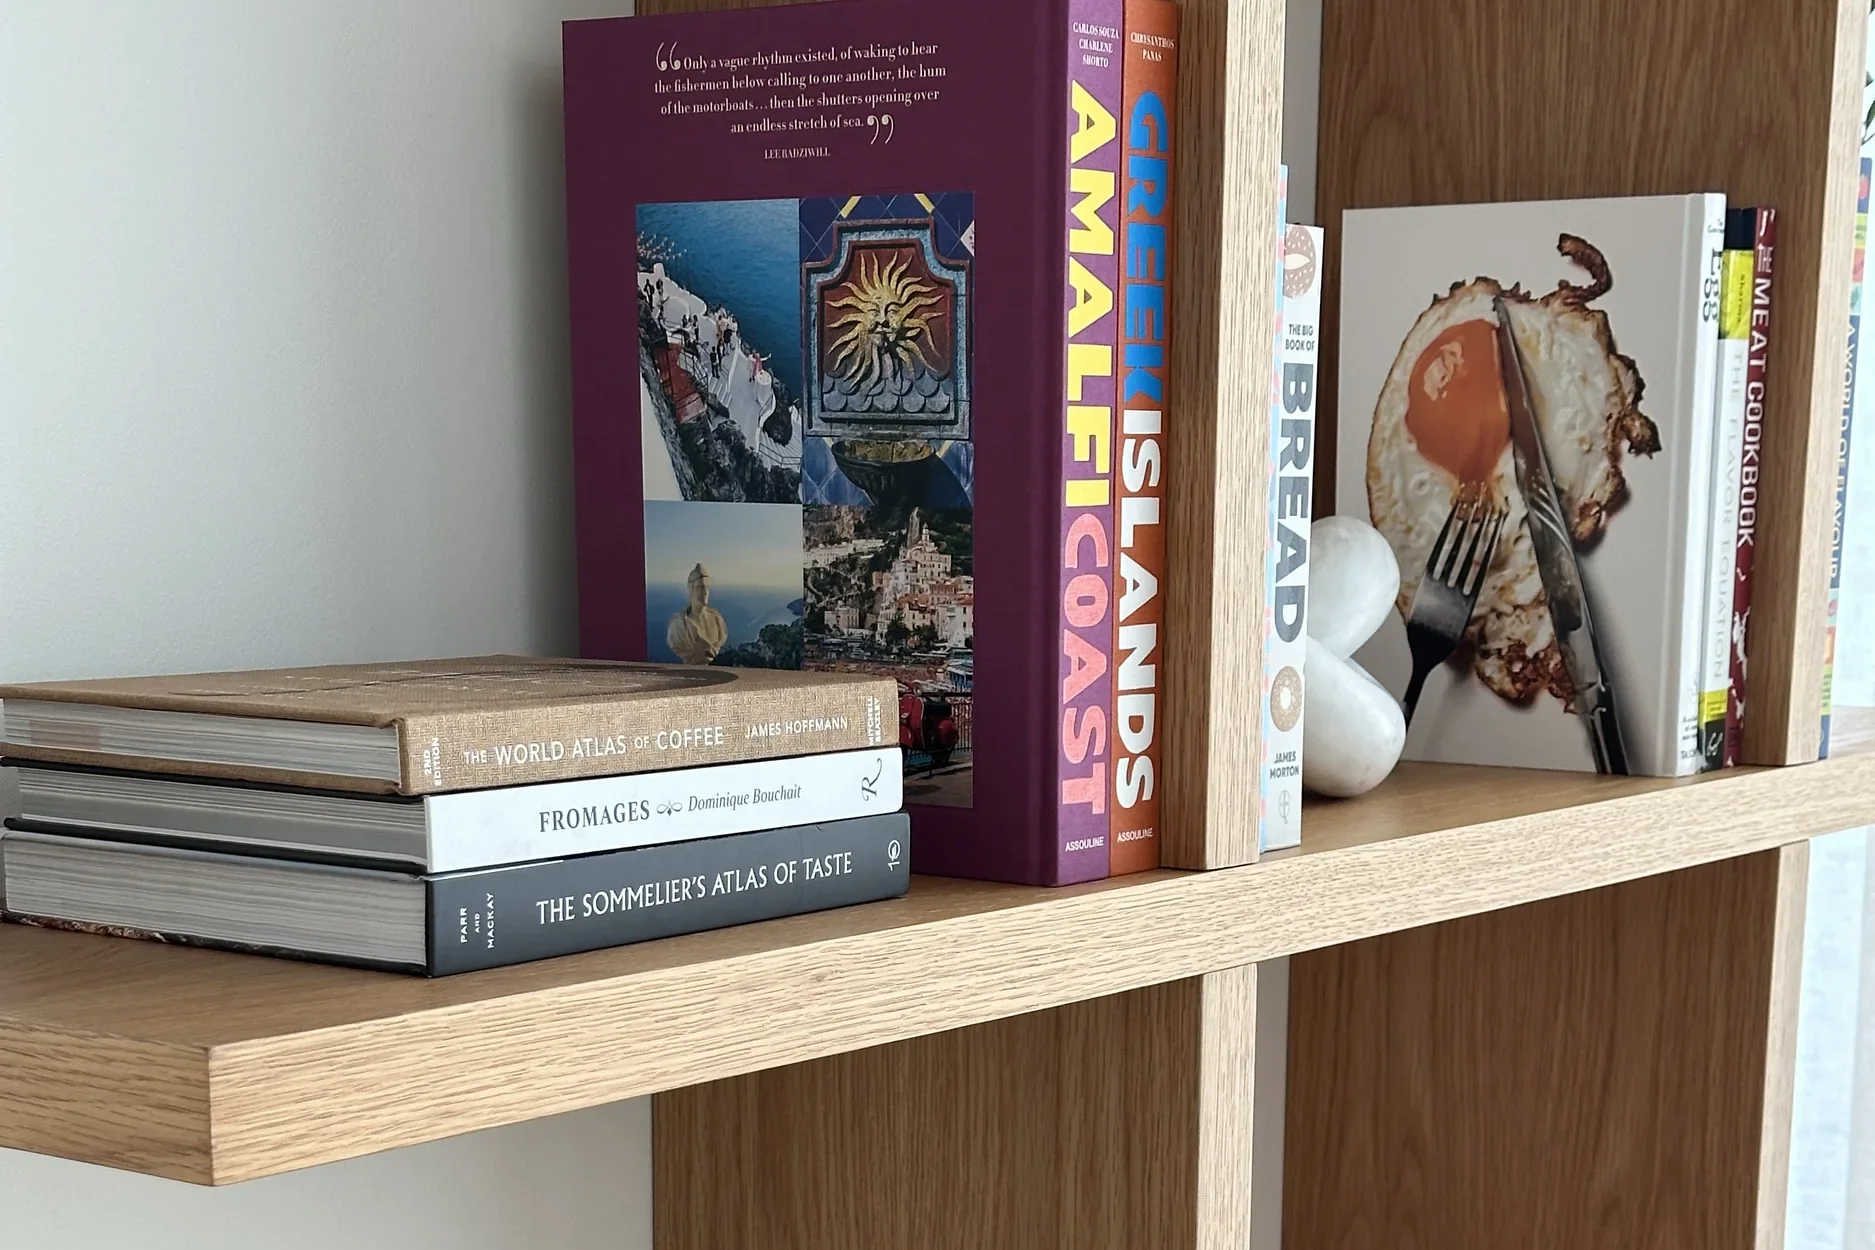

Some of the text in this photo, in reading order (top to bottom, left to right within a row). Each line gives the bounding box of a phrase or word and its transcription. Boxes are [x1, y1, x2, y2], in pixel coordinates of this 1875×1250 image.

[1073, 22, 1119, 39] CARLOS SOUZA
[1130, 32, 1175, 49] CHRYSANTHOS
[710, 58, 717, 69] a
[719, 56, 750, 72] vague
[751, 50, 793, 70] rhythm
[794, 46, 838, 63] existed,
[840, 46, 853, 60] of
[854, 44, 896, 62] waking
[898, 44, 909, 57] to
[911, 40, 939, 56] hear
[1078, 38, 1114, 54] CHARLENE
[1082, 54, 1109, 68] SHORTO
[1142, 49, 1162, 62] PANAS
[654, 63, 947, 93] the fishermen below calling to one another, the hum
[660, 100, 672, 115] of
[673, 100, 691, 114] the
[797, 93, 815, 108] the
[816, 92, 863, 107] shutters
[864, 88, 912, 109] opening
[913, 90, 940, 101] over
[730, 124, 744, 133] an
[746, 117, 787, 132] endless
[788, 114, 828, 130] stretch
[829, 113, 843, 129] of
[764, 147, 831, 160] LEE RADZIWILL
[1065, 80, 1117, 507] AMALFI
[1288, 323, 1314, 337] THE BIG
[1749, 278, 1772, 373] MEAT
[1284, 338, 1315, 352] BOOK OF
[1116, 91, 1168, 810] GREEK ISLANDS
[1737, 381, 1765, 548] COOKBOOK
[1274, 363, 1314, 643] BREAD
[1062, 513, 1109, 815] COAST
[744, 715, 849, 740] JAMES HOFFMANN
[866, 699, 874, 746] MITCHELL
[873, 698, 882, 743] BEAZLEY
[463, 749, 490, 765] THE
[494, 740, 566, 766] WORLD
[571, 735, 627, 761] ATLAS
[656, 725, 725, 751] COFFEE
[1273, 750, 1297, 764] JAMES
[423, 750, 432, 775] 2ND
[432, 736, 442, 786] EDITION
[1269, 764, 1300, 780] MORTON
[687, 783, 802, 813] Dominique Bouchait
[538, 799, 651, 834] FROMAGES
[1065, 836, 1104, 853] ASSOULINE
[1117, 827, 1154, 843] ASSOULINE
[535, 851, 853, 926] THE SOMMELIER'S ATLAS OF TASTE
[459, 906, 468, 944] PARR
[486, 891, 496, 950] MACKAY
